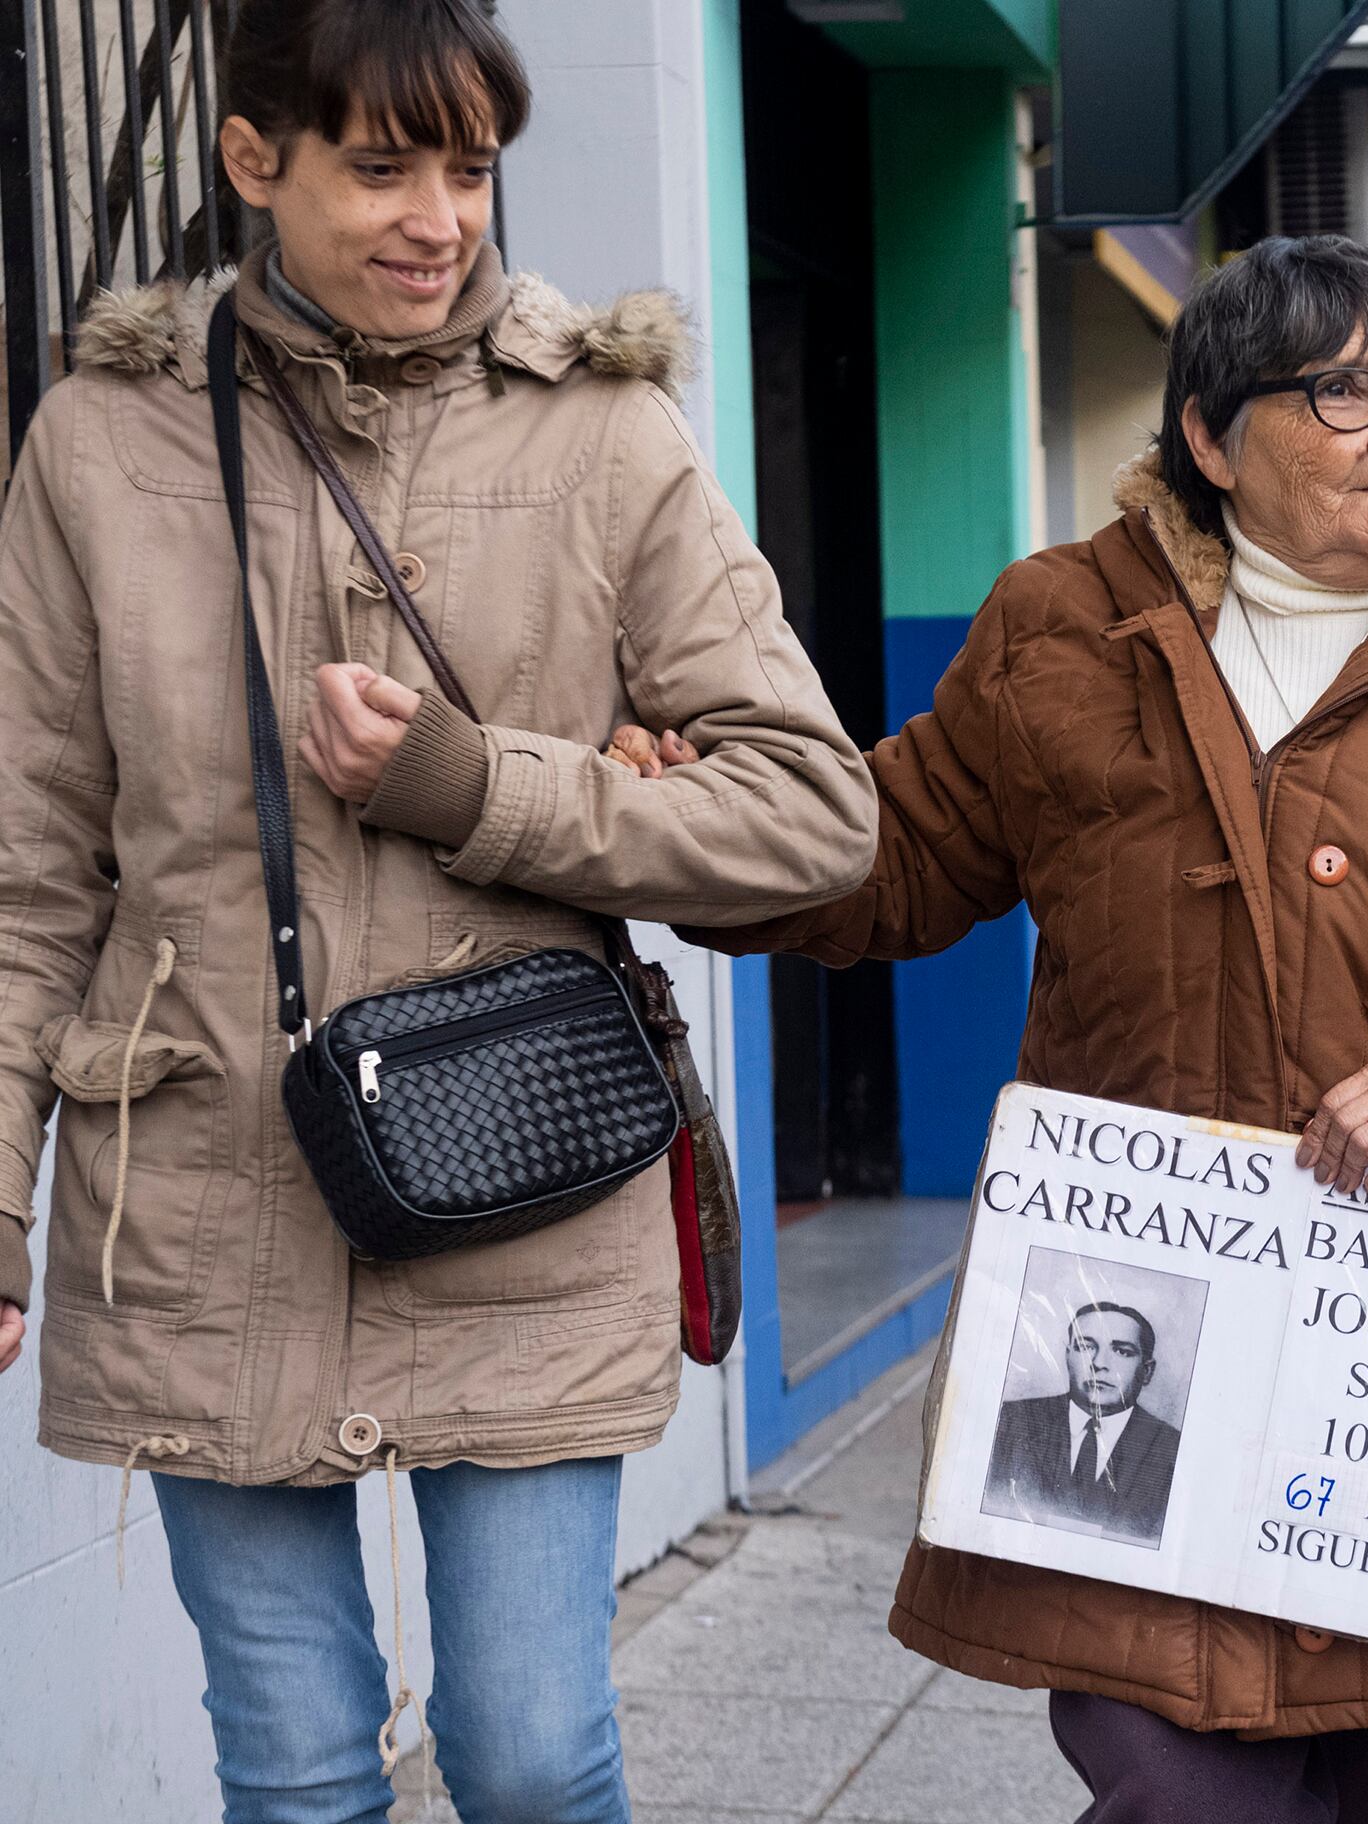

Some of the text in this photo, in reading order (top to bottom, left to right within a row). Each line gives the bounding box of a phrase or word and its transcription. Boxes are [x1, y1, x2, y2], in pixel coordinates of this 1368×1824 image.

[1024, 1107, 1273, 1196] NICOLAS
[982, 1170, 1291, 1271] CARRANZA
[1285, 1472, 1337, 1518] 67
